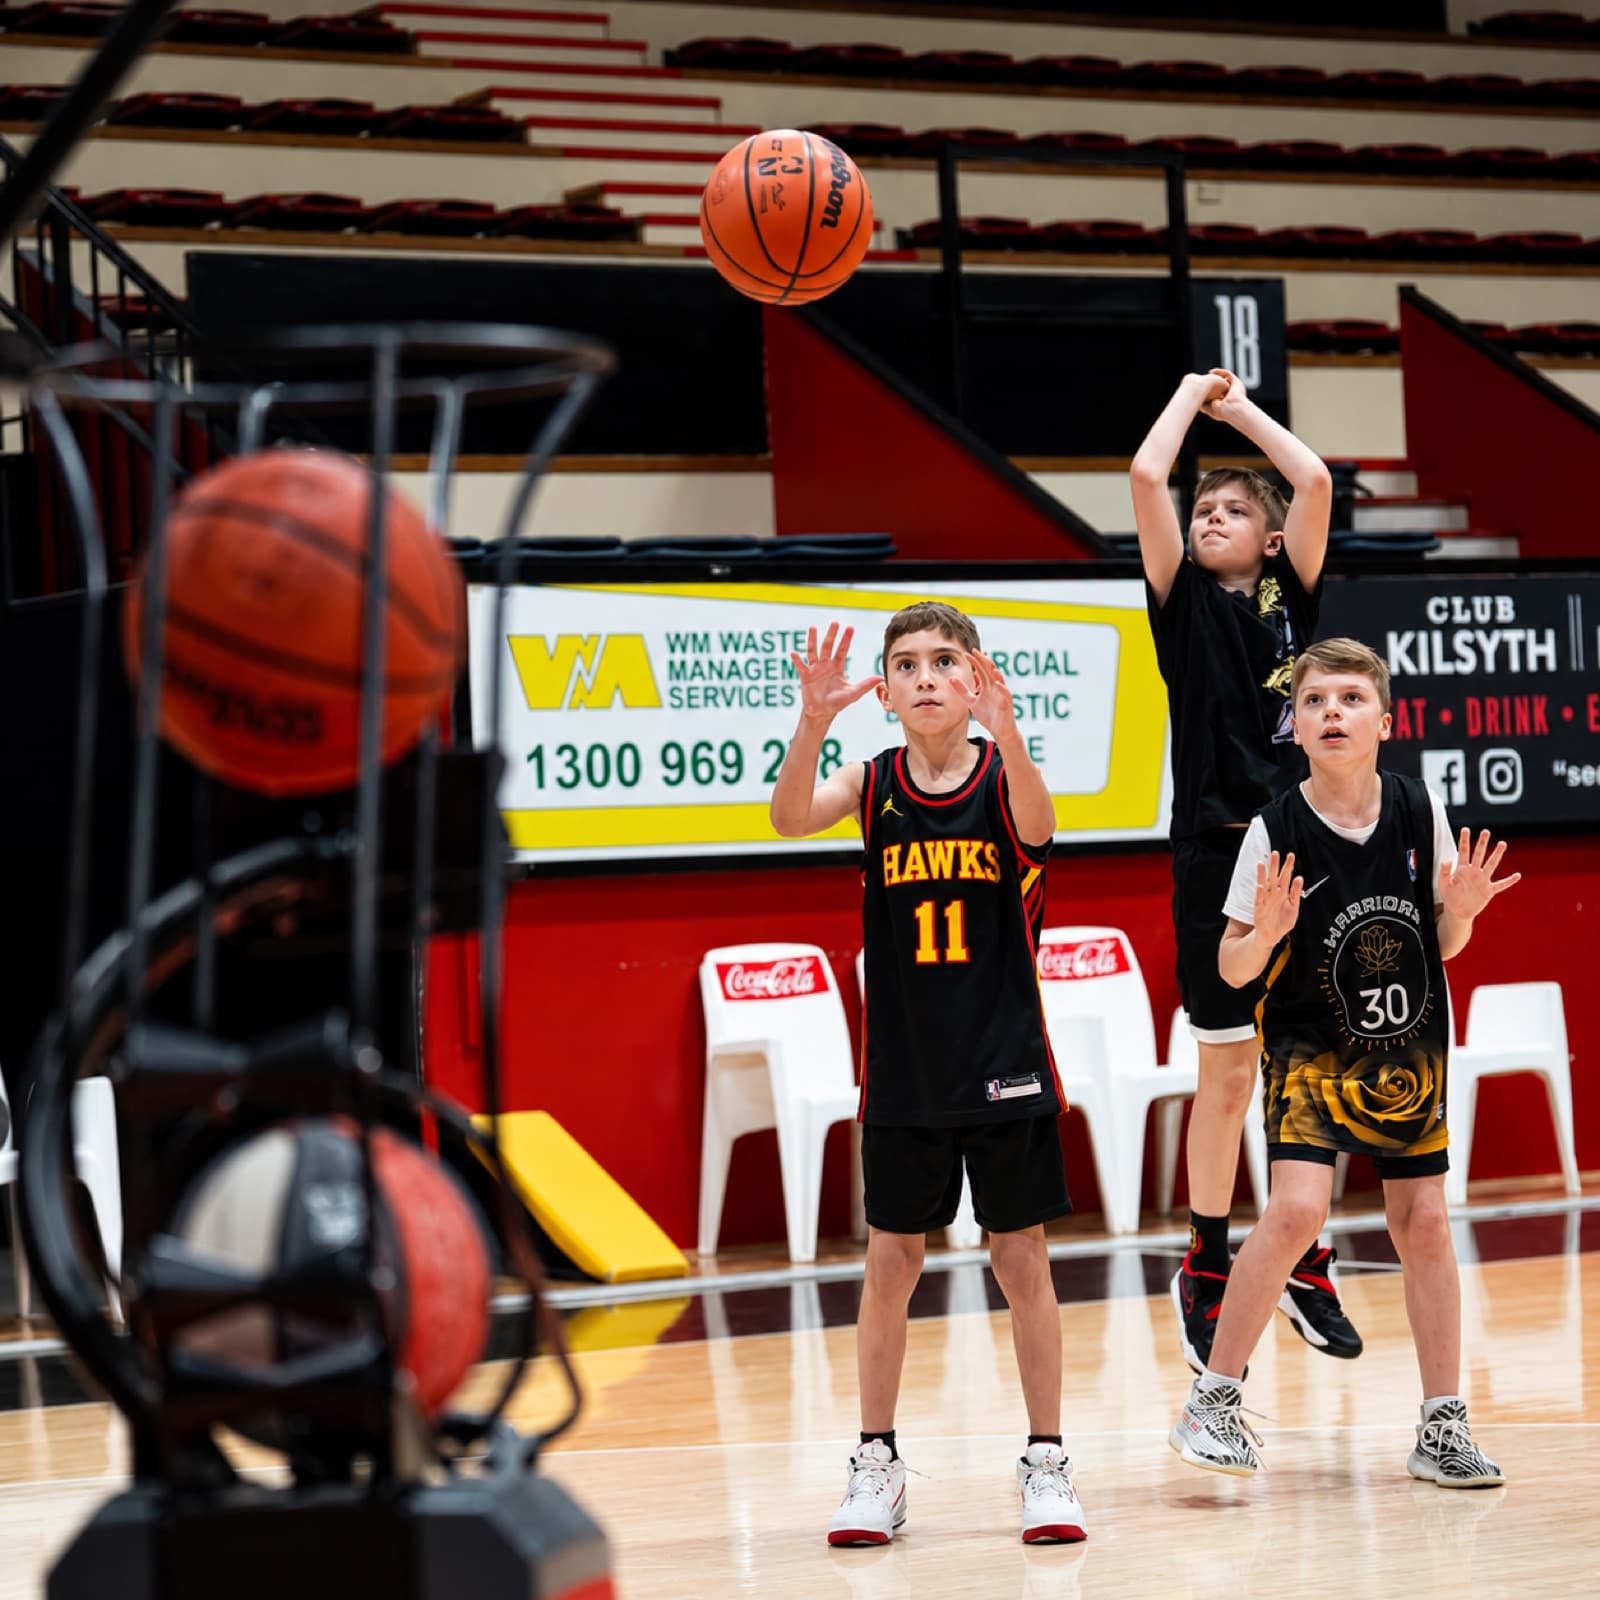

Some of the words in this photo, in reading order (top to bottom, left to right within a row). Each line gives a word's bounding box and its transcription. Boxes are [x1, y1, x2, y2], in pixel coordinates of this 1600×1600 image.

[1214, 294, 1262, 389] 18
[1427, 596, 1515, 624] CLUB
[666, 631, 711, 654] WM
[719, 630, 807, 653] WASTE
[1387, 628, 1557, 675] KILSYTH
[669, 685, 796, 709] SERVICES
[1389, 697, 1428, 740] AT
[1466, 695, 1549, 737] DRINK
[526, 744, 642, 790] 1300
[660, 742, 744, 787] 969
[762, 738, 843, 783] 28
[882, 839, 1001, 887] HAWKS
[914, 899, 970, 965] 11
[724, 958, 815, 999] Coca-Cola
[1359, 983, 1410, 1031] 30
